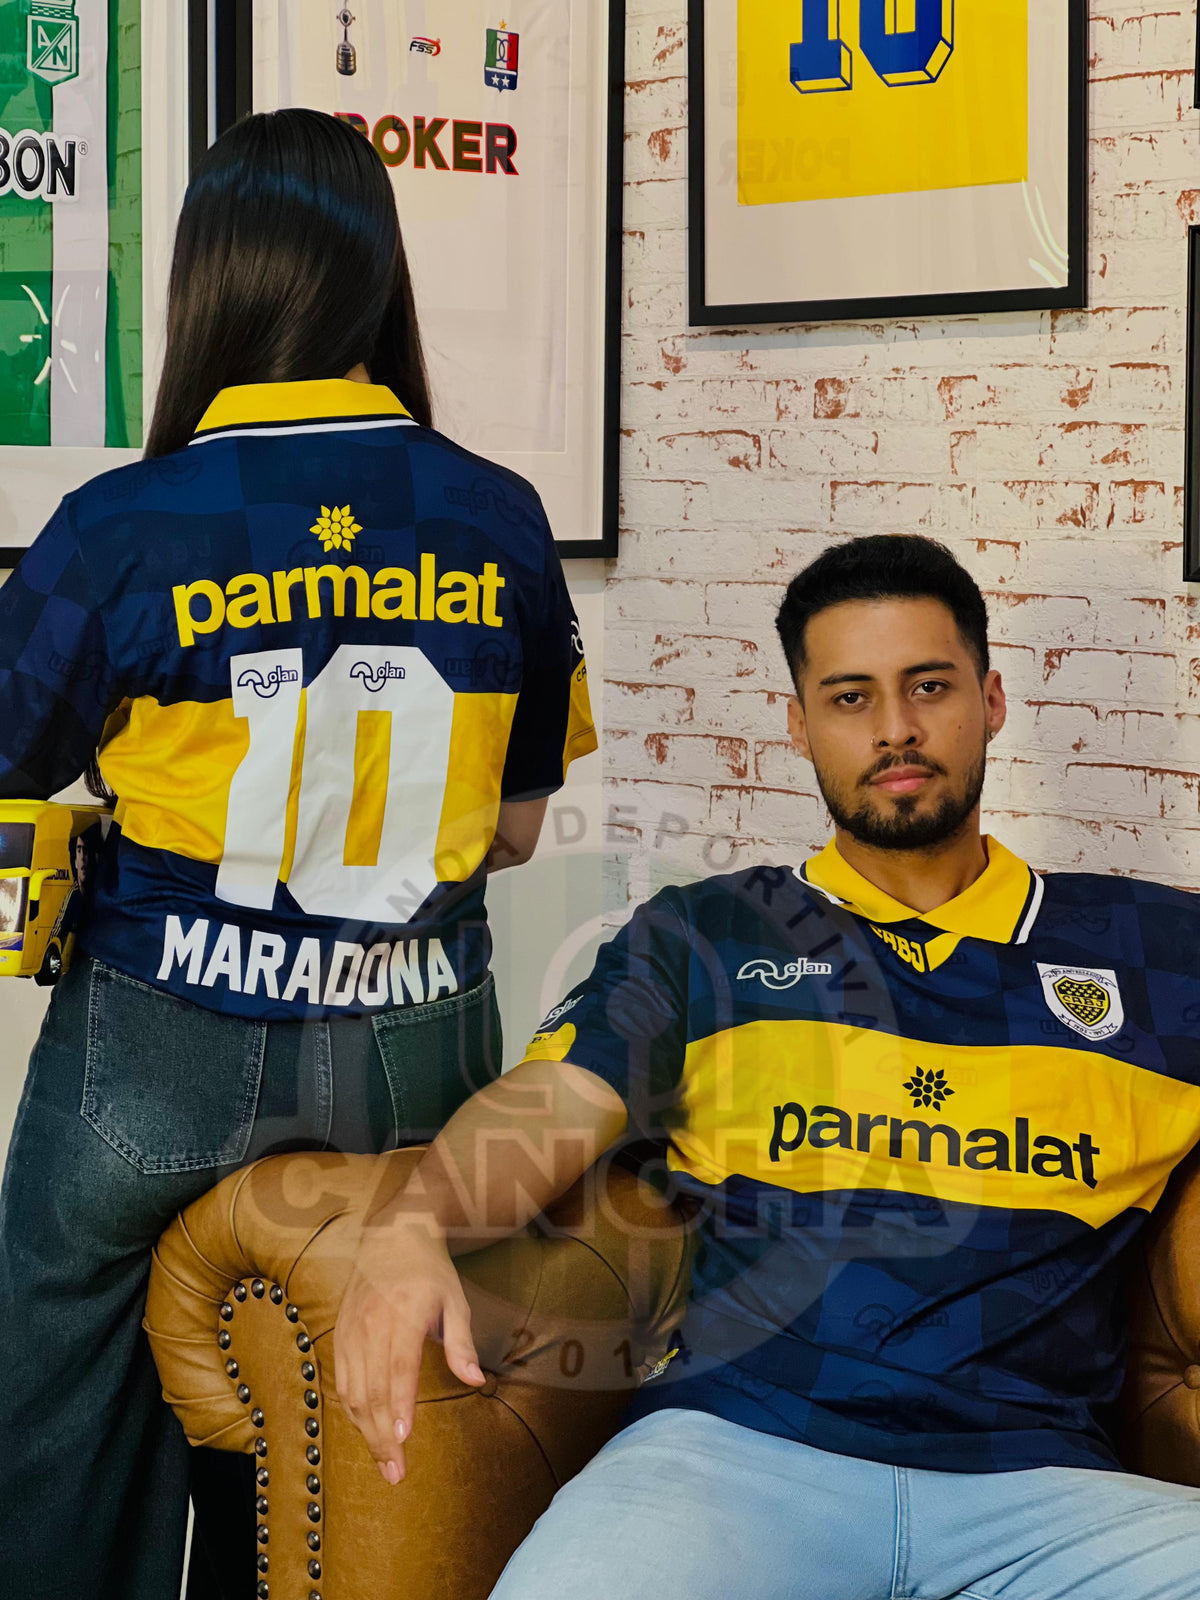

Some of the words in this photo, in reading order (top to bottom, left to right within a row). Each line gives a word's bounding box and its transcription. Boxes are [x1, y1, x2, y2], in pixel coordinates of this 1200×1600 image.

[172, 552, 506, 648] parmalat
[215, 644, 455, 924] 10
[156, 915, 458, 1007] MARADONA
[768, 1100, 1101, 1190] parmalat
